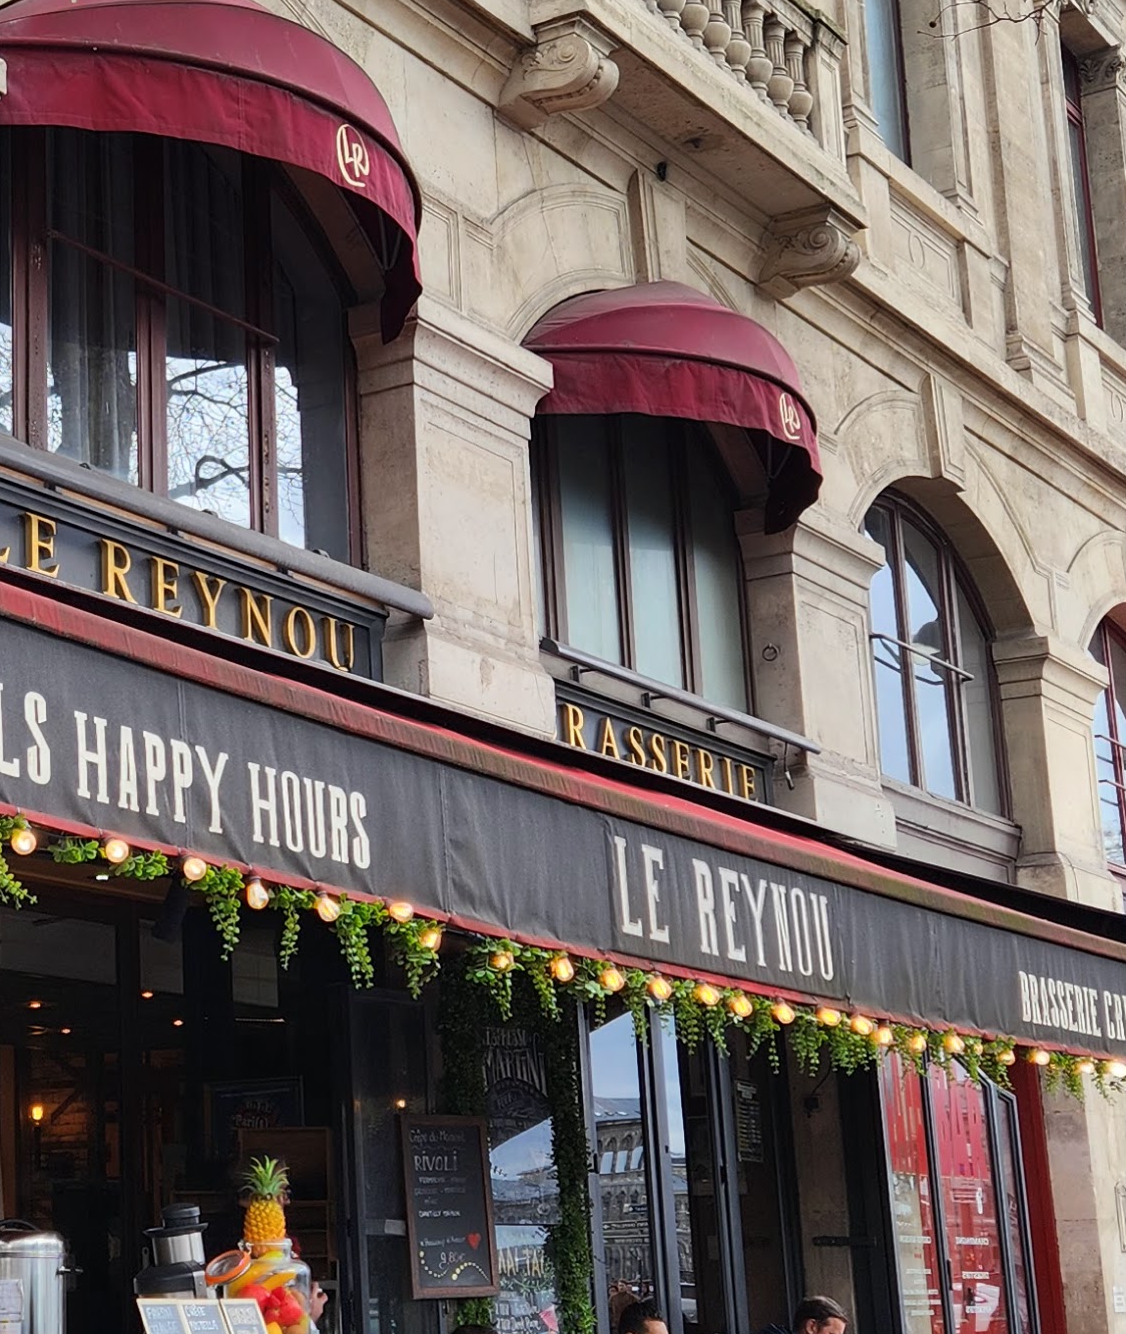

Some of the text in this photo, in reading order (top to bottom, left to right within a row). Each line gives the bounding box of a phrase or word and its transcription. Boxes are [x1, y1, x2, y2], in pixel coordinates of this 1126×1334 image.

[98, 536, 357, 672] REYNOU
[74, 710, 229, 835] HAPPY
[247, 761, 372, 870] HOURS
[562, 702, 760, 803] RASSERIE
[613, 835, 835, 982] LE REYNOU
[1018, 970, 1103, 1038] BRASSERIE
[414, 1151, 458, 1172] RIVOLI
